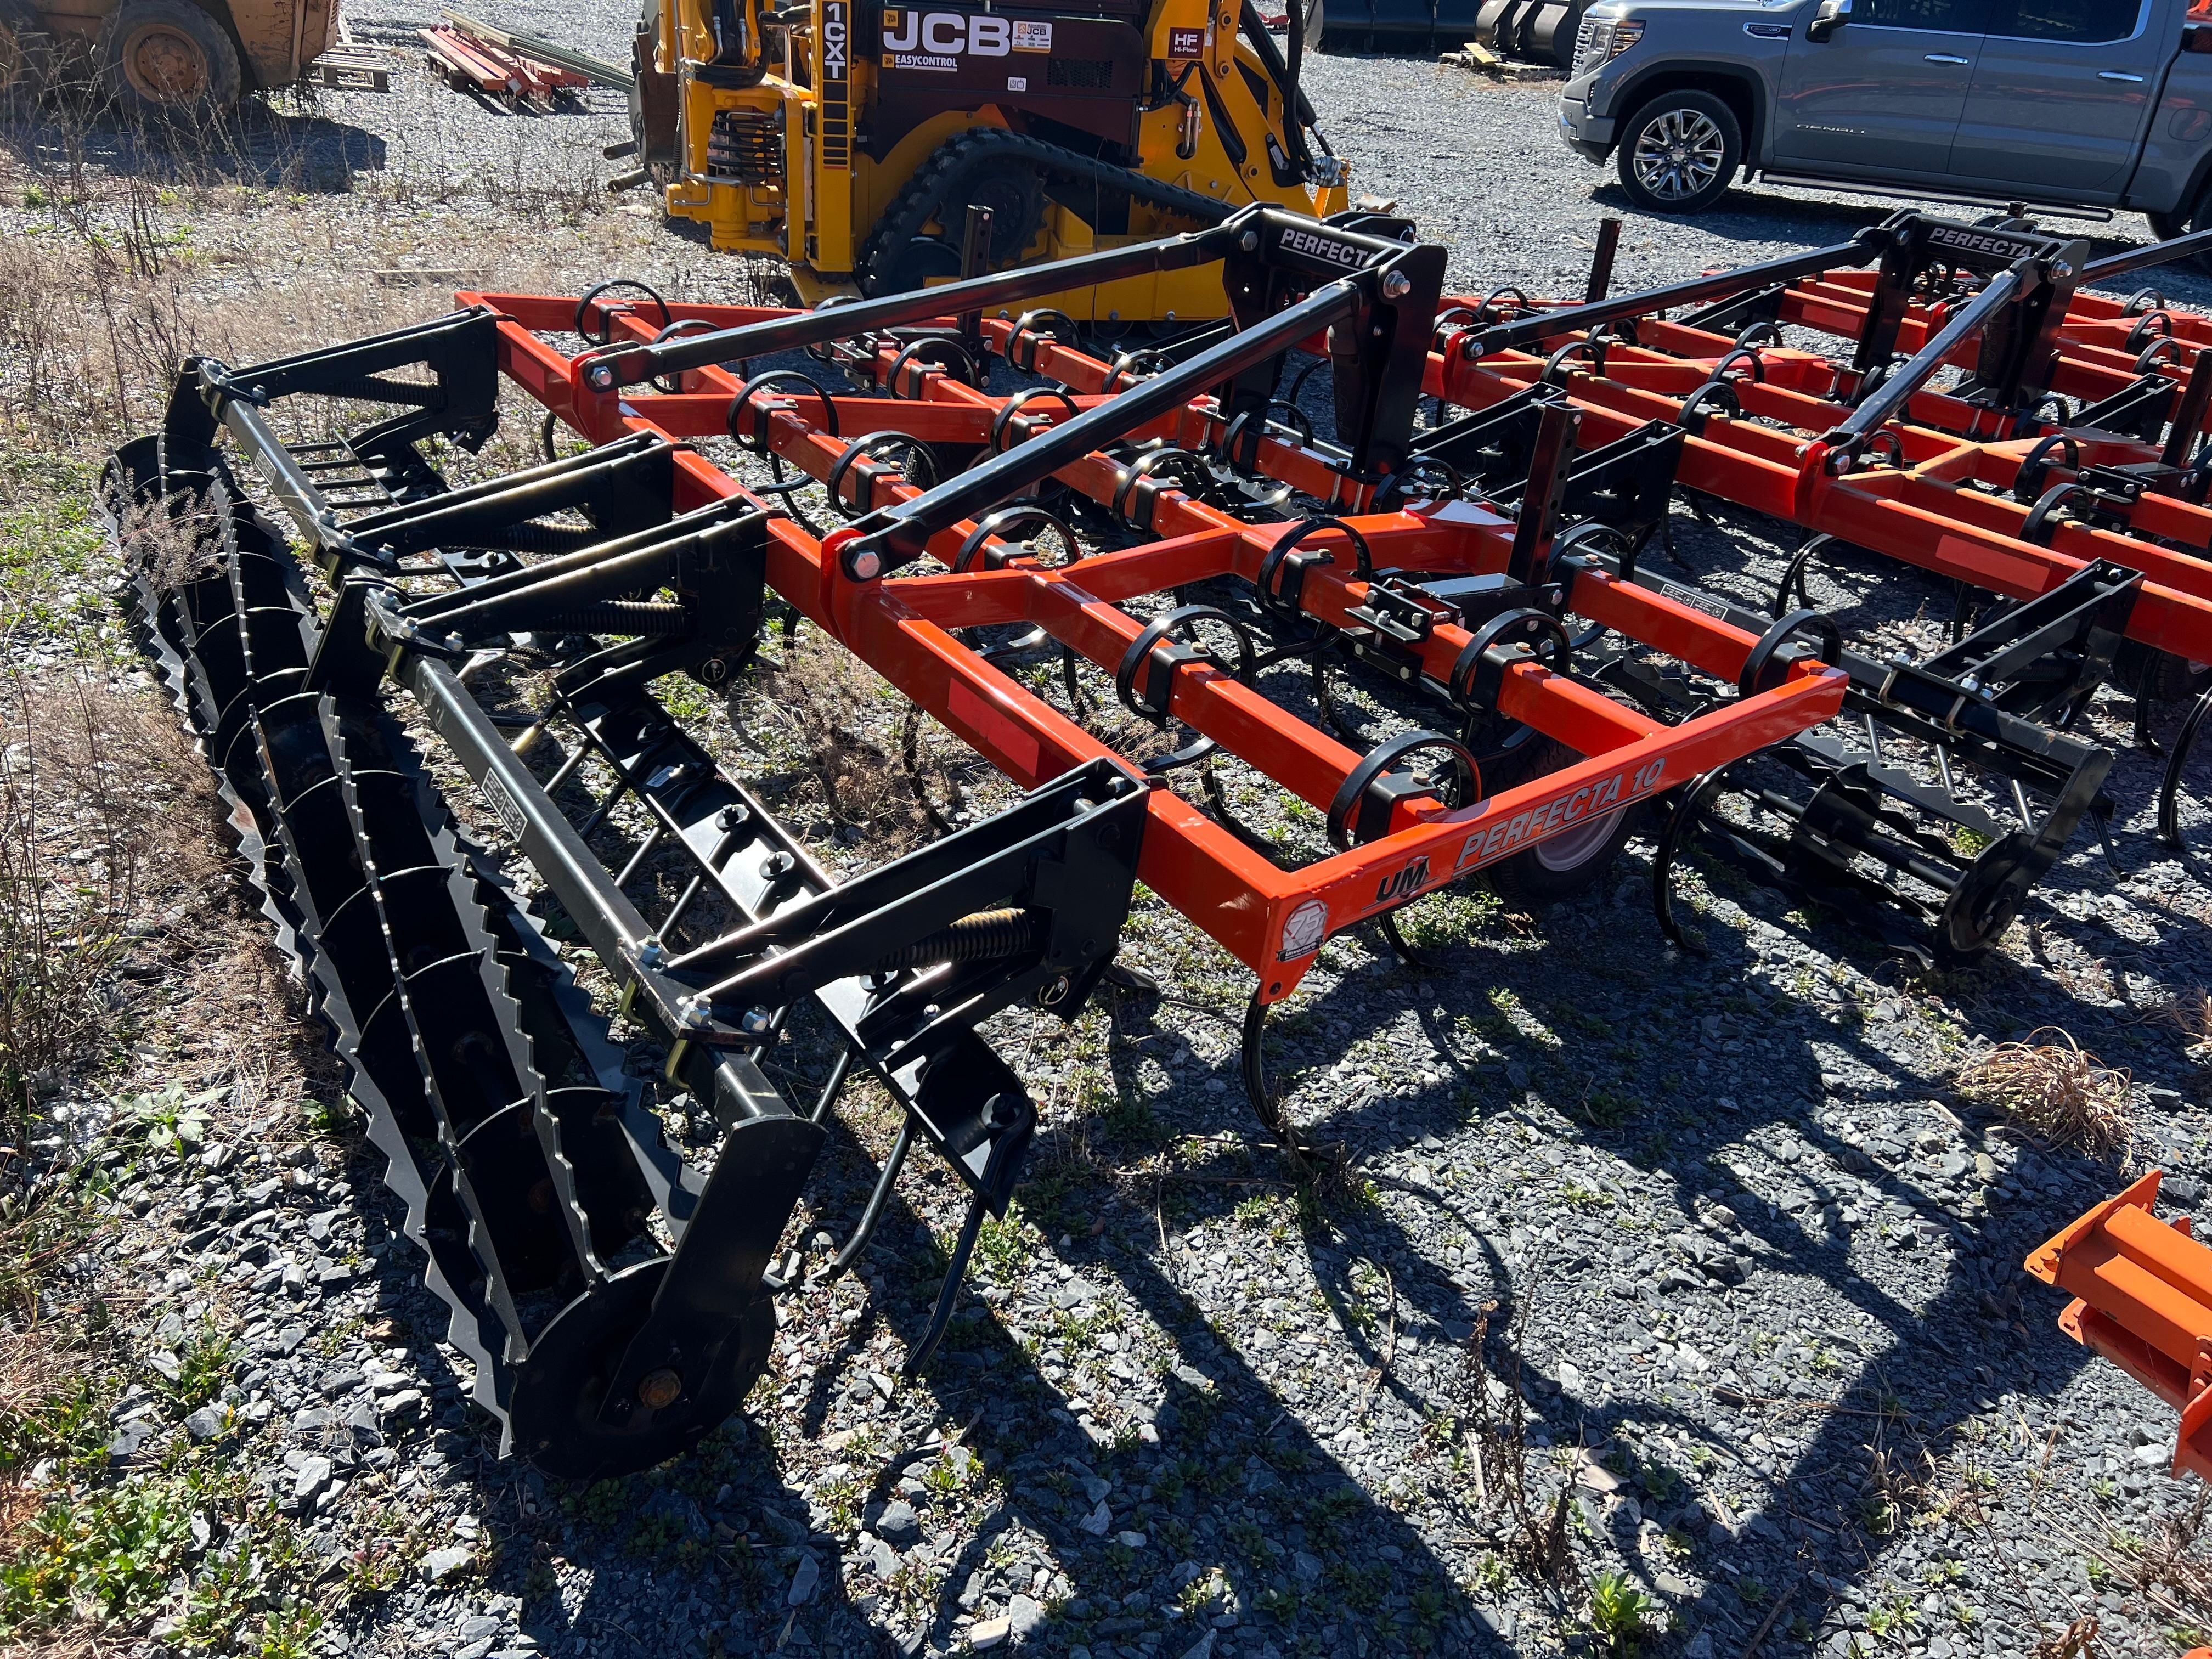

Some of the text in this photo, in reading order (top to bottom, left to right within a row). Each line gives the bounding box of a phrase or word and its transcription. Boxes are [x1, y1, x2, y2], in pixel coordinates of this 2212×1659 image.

[825, 2, 845, 79] 1CXT
[883, 10, 1011, 57] JCB
[1175, 33, 1198, 46] HF
[895, 54, 957, 67] EASYCONTROL
[1929, 227, 2032, 257] PERFECTA
[1454, 757, 1666, 868] PERFECTA 10
[1376, 857, 1429, 902] UM
[1290, 911, 1321, 936] 75
